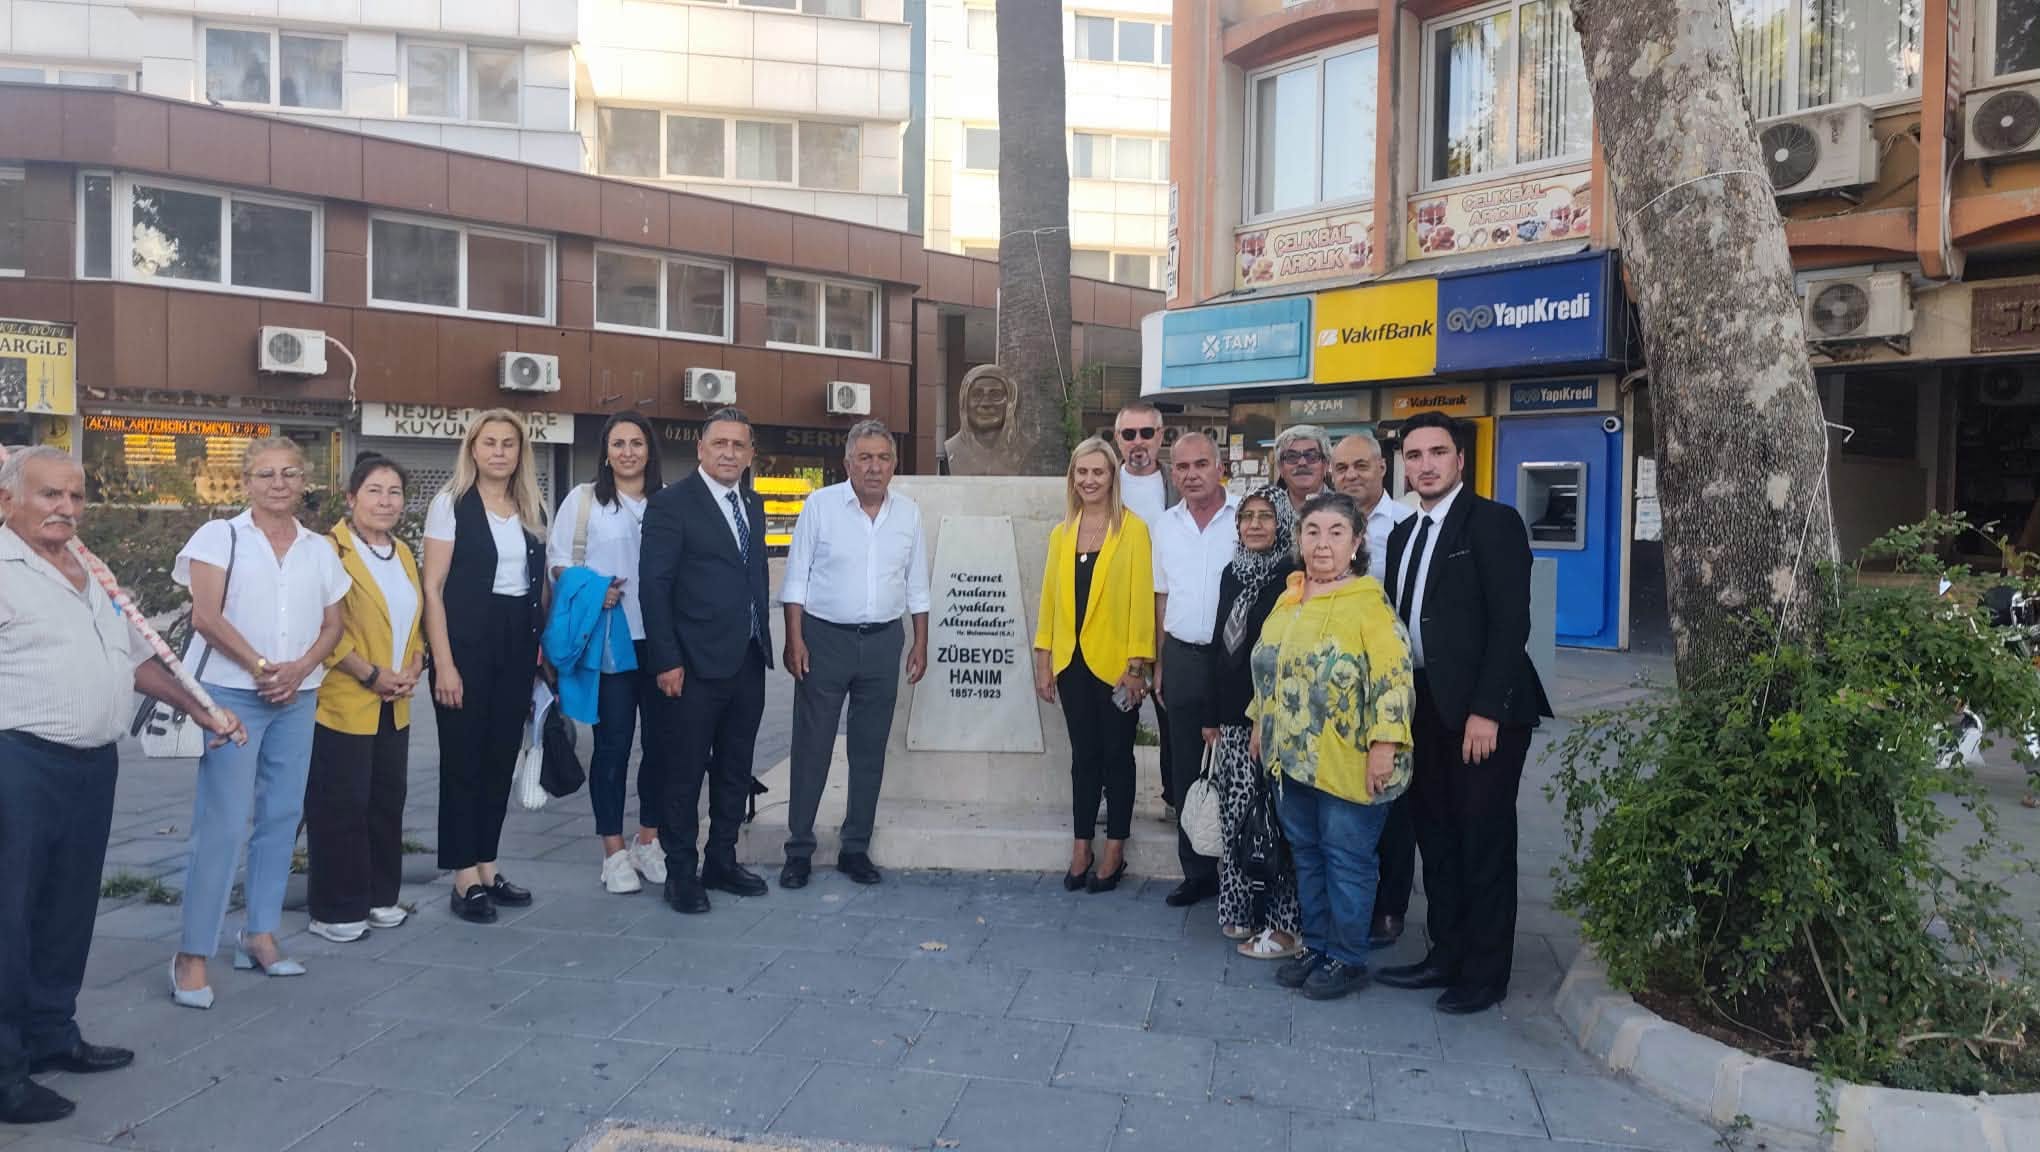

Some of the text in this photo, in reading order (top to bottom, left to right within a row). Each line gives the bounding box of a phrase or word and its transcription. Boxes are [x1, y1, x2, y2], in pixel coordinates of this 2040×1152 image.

[1222, 333, 1258, 352] TAM
[384, 403, 474, 422] NEJDET
[1318, 399, 1343, 411] TAM
[937, 644, 1014, 664] ZÜBEYDE
[950, 668, 1002, 685] HANIM
[950, 688, 1001, 698] 1857-1923
